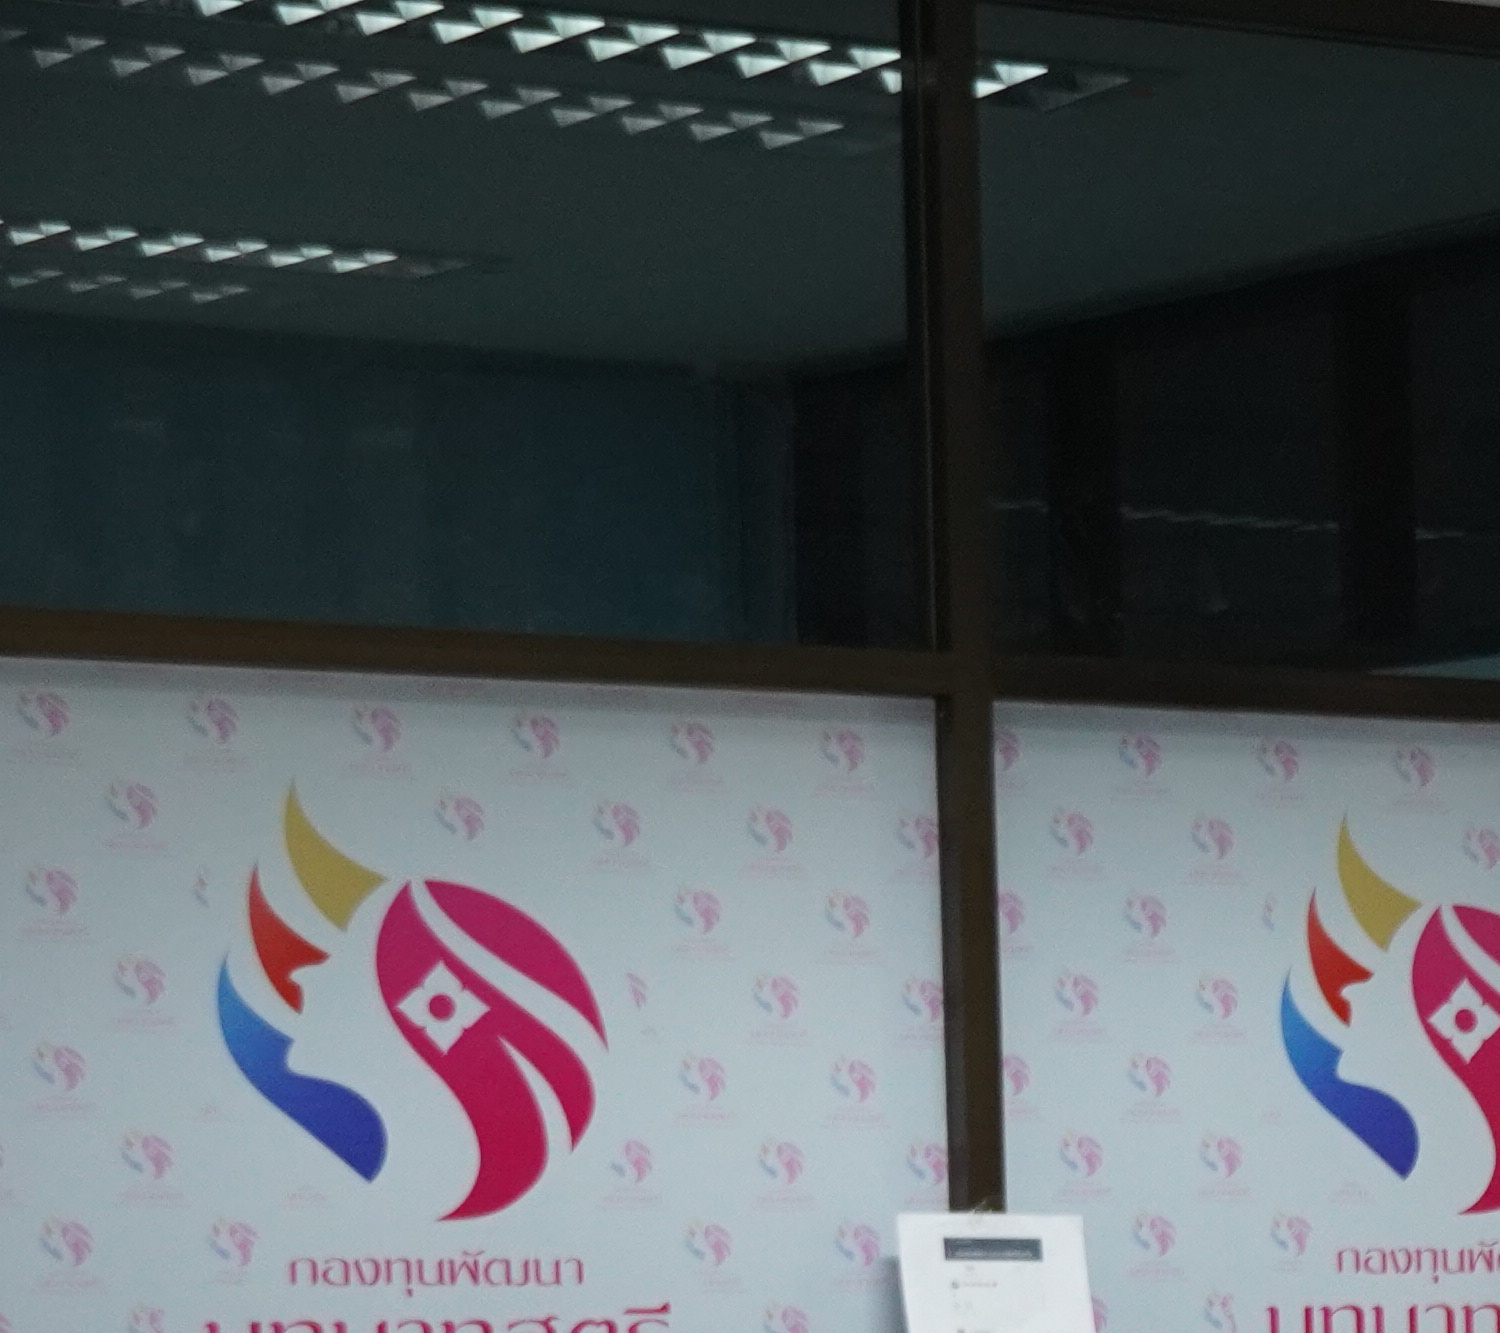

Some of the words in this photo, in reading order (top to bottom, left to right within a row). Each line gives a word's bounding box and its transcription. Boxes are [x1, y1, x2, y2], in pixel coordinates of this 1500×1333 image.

[287, 1250, 586, 1298] กองทุนพัฒนา
